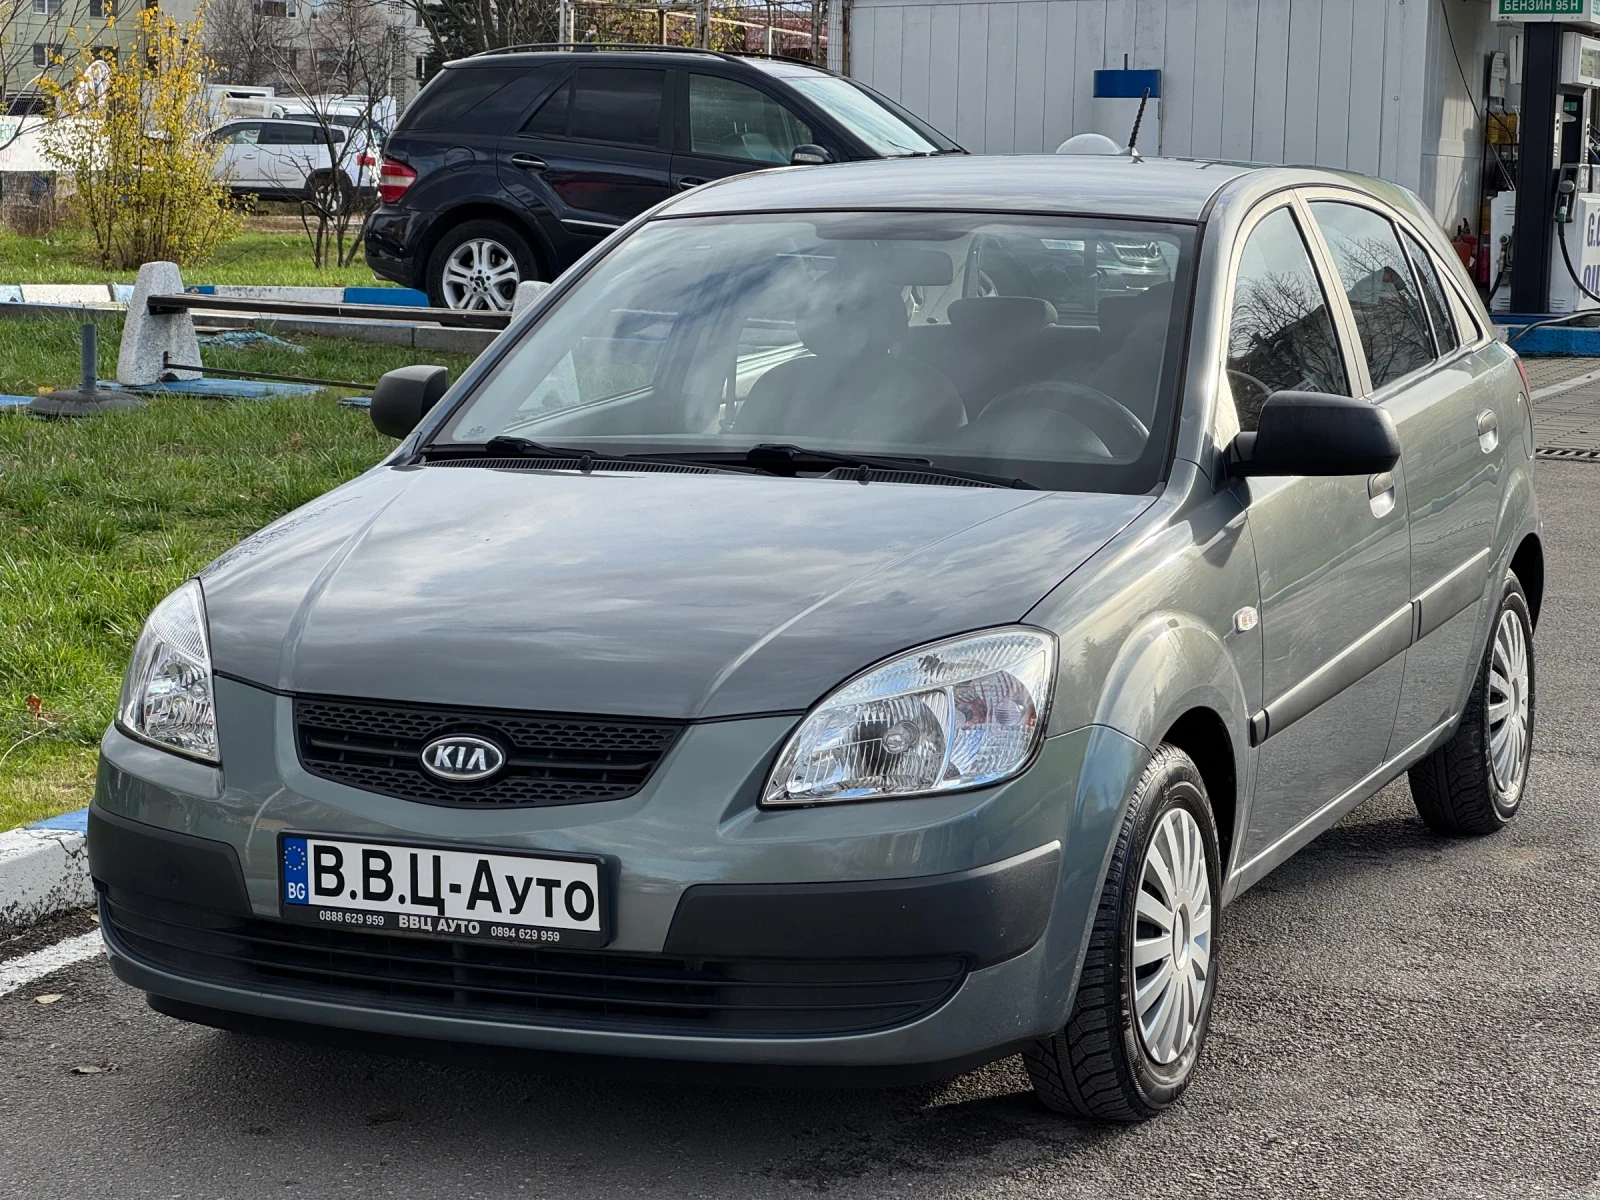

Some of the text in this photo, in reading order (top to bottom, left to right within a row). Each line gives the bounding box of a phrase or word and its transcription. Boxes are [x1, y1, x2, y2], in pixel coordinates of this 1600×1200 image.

[1504, 0, 1552, 10] БЕНЗИН
[434, 745, 487, 770] KIA
[288, 882, 306, 900] BG
[319, 910, 384, 926] 0888 629 959
[399, 915, 480, 935] ВВЦ АУТО
[491, 926, 560, 942] 0894 629 959
